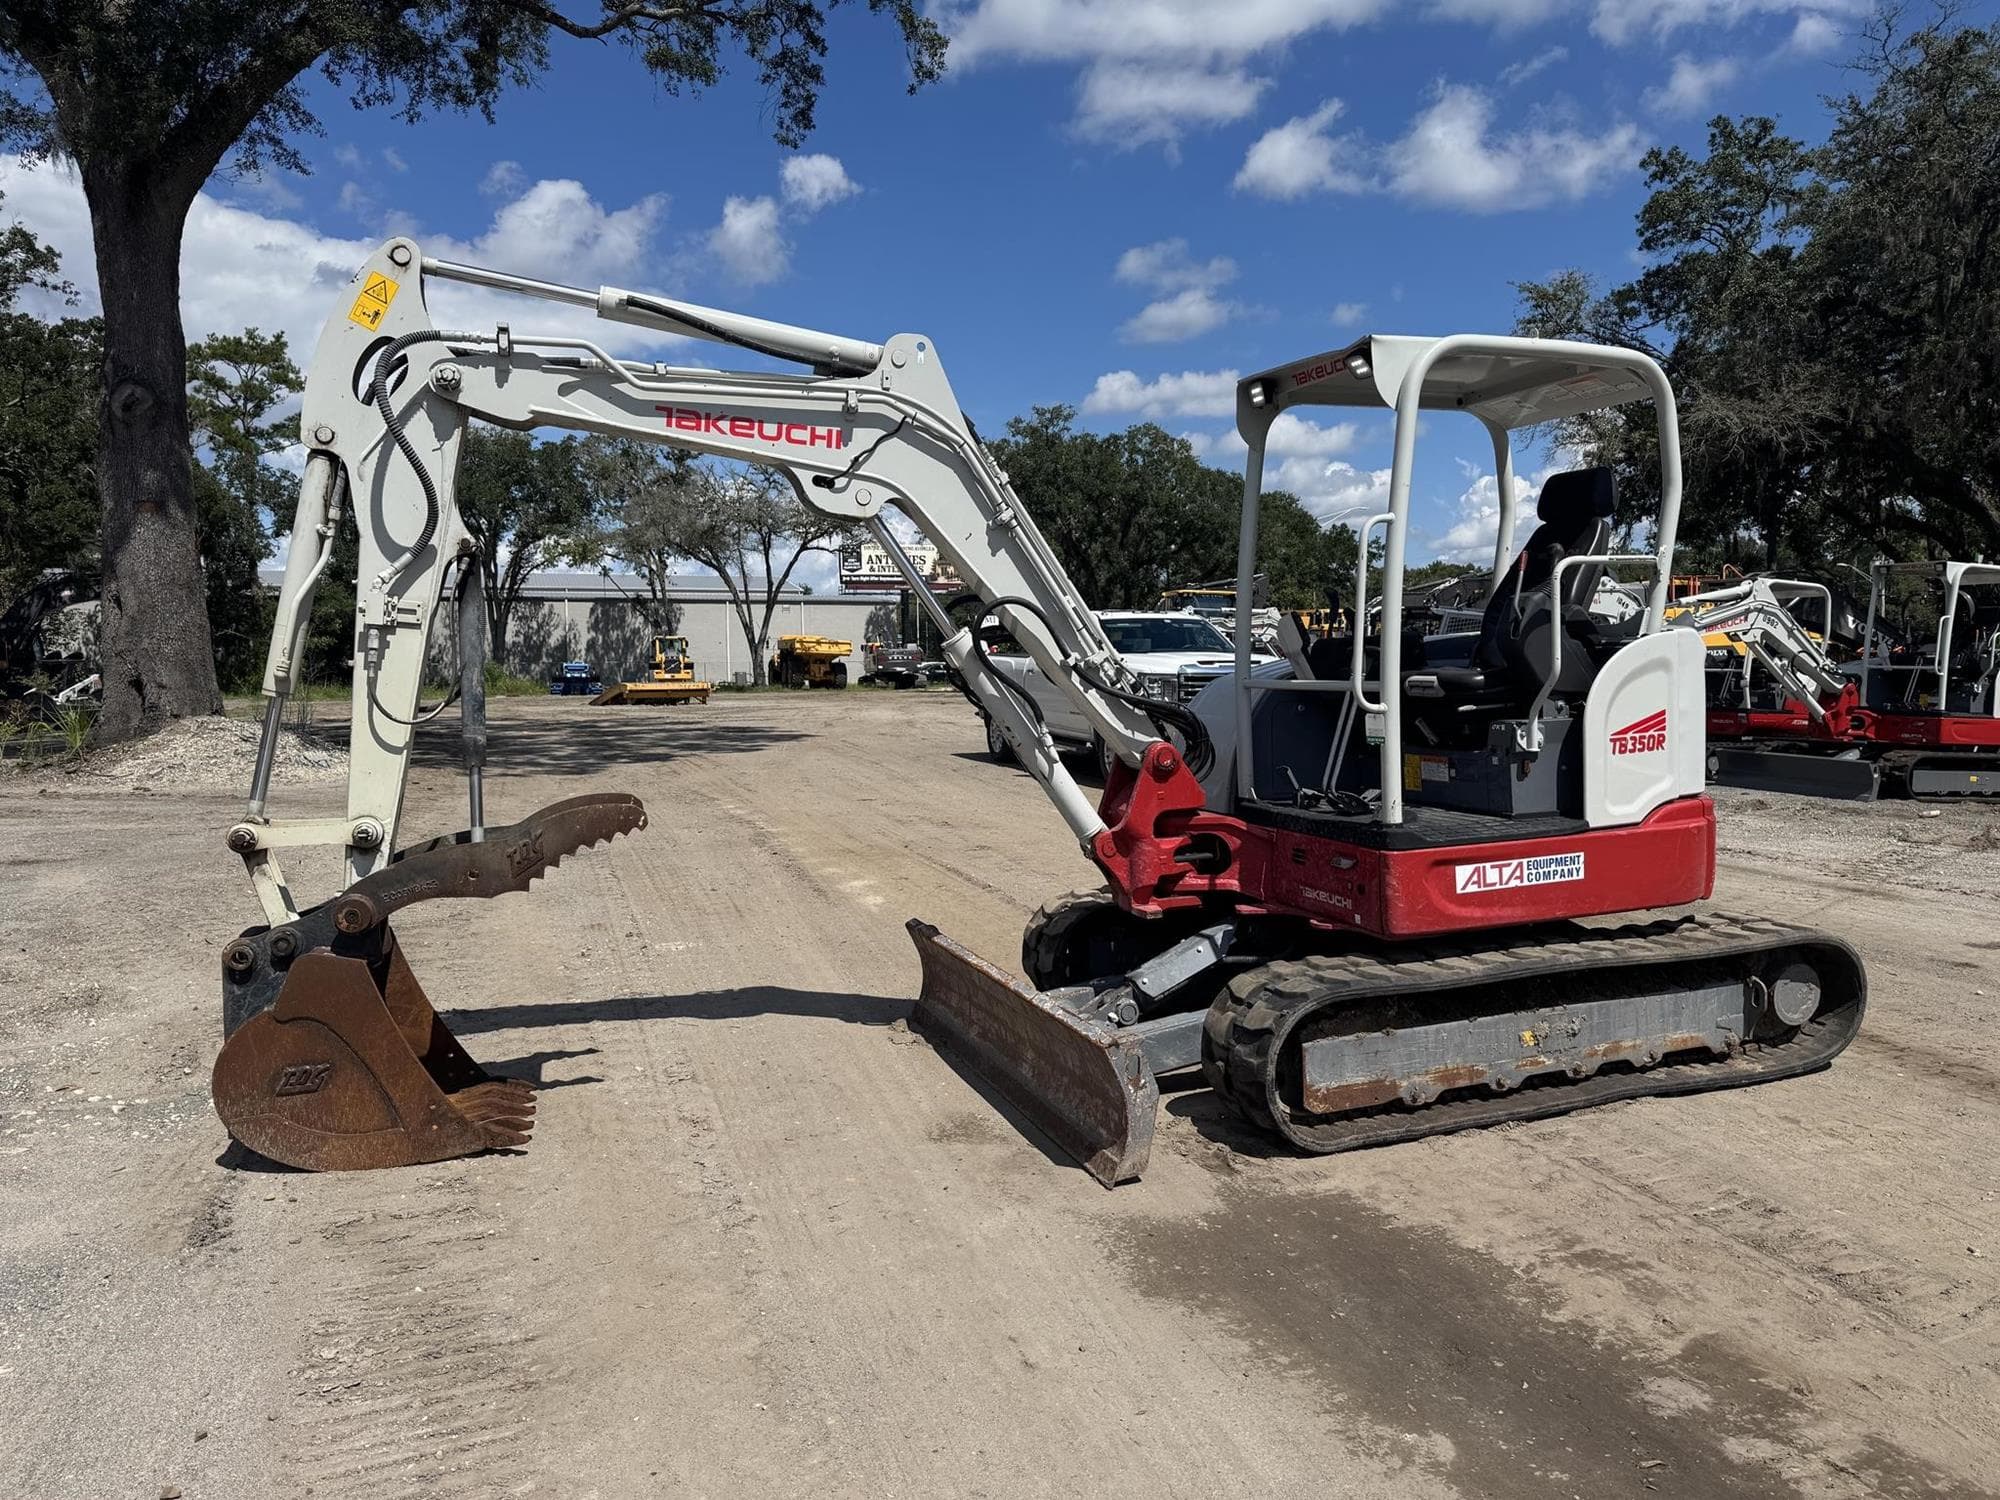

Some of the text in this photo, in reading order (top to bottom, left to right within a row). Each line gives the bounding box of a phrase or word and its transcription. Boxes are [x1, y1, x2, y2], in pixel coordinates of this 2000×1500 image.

[1292, 358, 1347, 386] TAKEUC
[655, 405, 842, 450] TAKEUCHI
[867, 555, 927, 565] ANTES
[1609, 733, 1666, 755] TB350R
[1526, 855, 1582, 871] EQUIPMENT
[1460, 861, 1525, 891] ALTA
[1527, 867, 1582, 883] COMPANY
